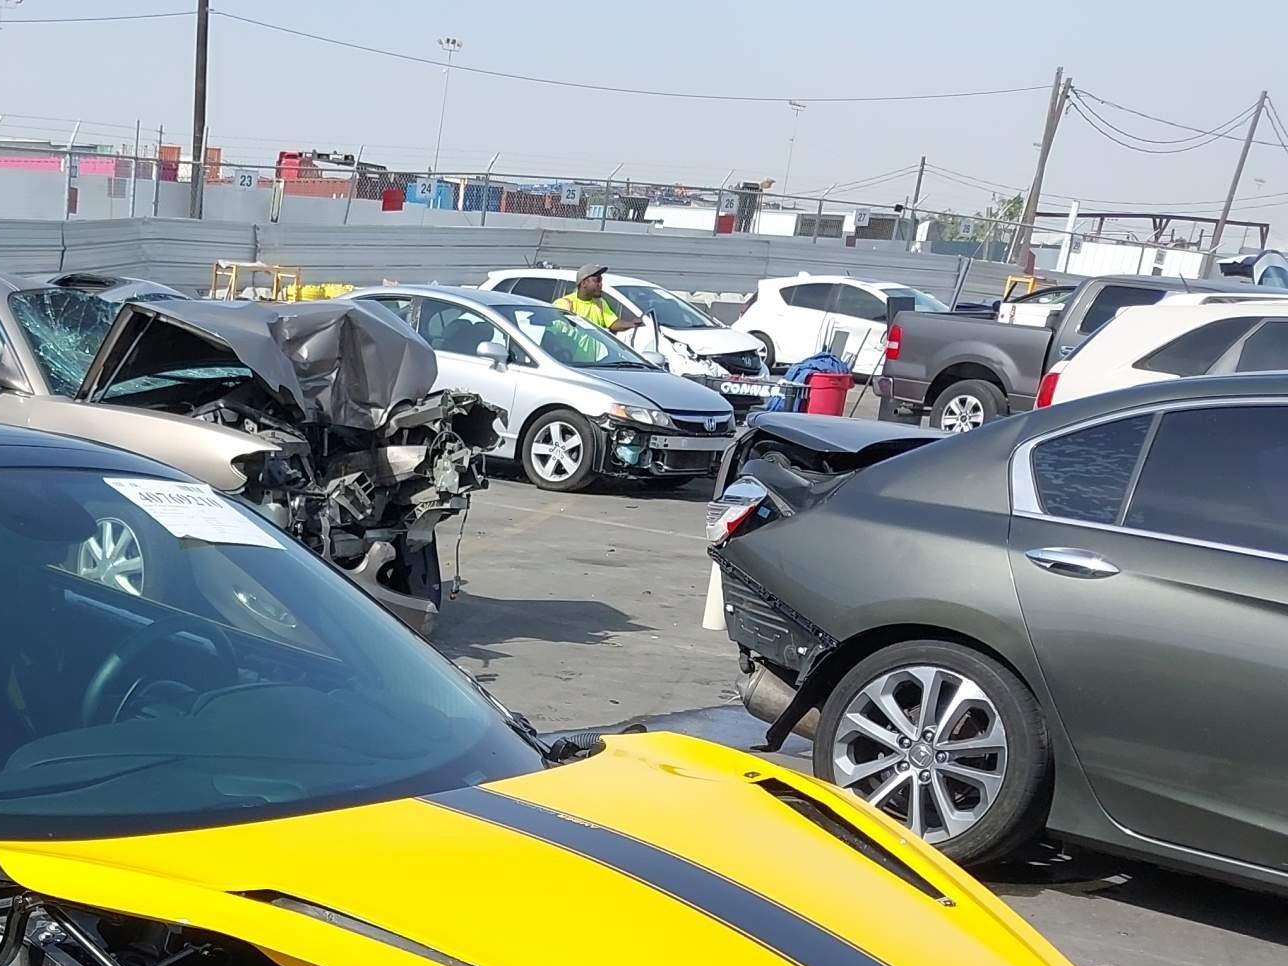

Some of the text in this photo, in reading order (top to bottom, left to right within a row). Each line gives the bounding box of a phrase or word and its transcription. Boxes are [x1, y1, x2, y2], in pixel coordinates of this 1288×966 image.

[240, 175, 252, 187] 23
[421, 183, 432, 194] 24
[566, 189, 576, 200] 25
[725, 198, 734, 209] 26
[857, 213, 867, 222] 27
[138, 491, 223, 509] 40769210
